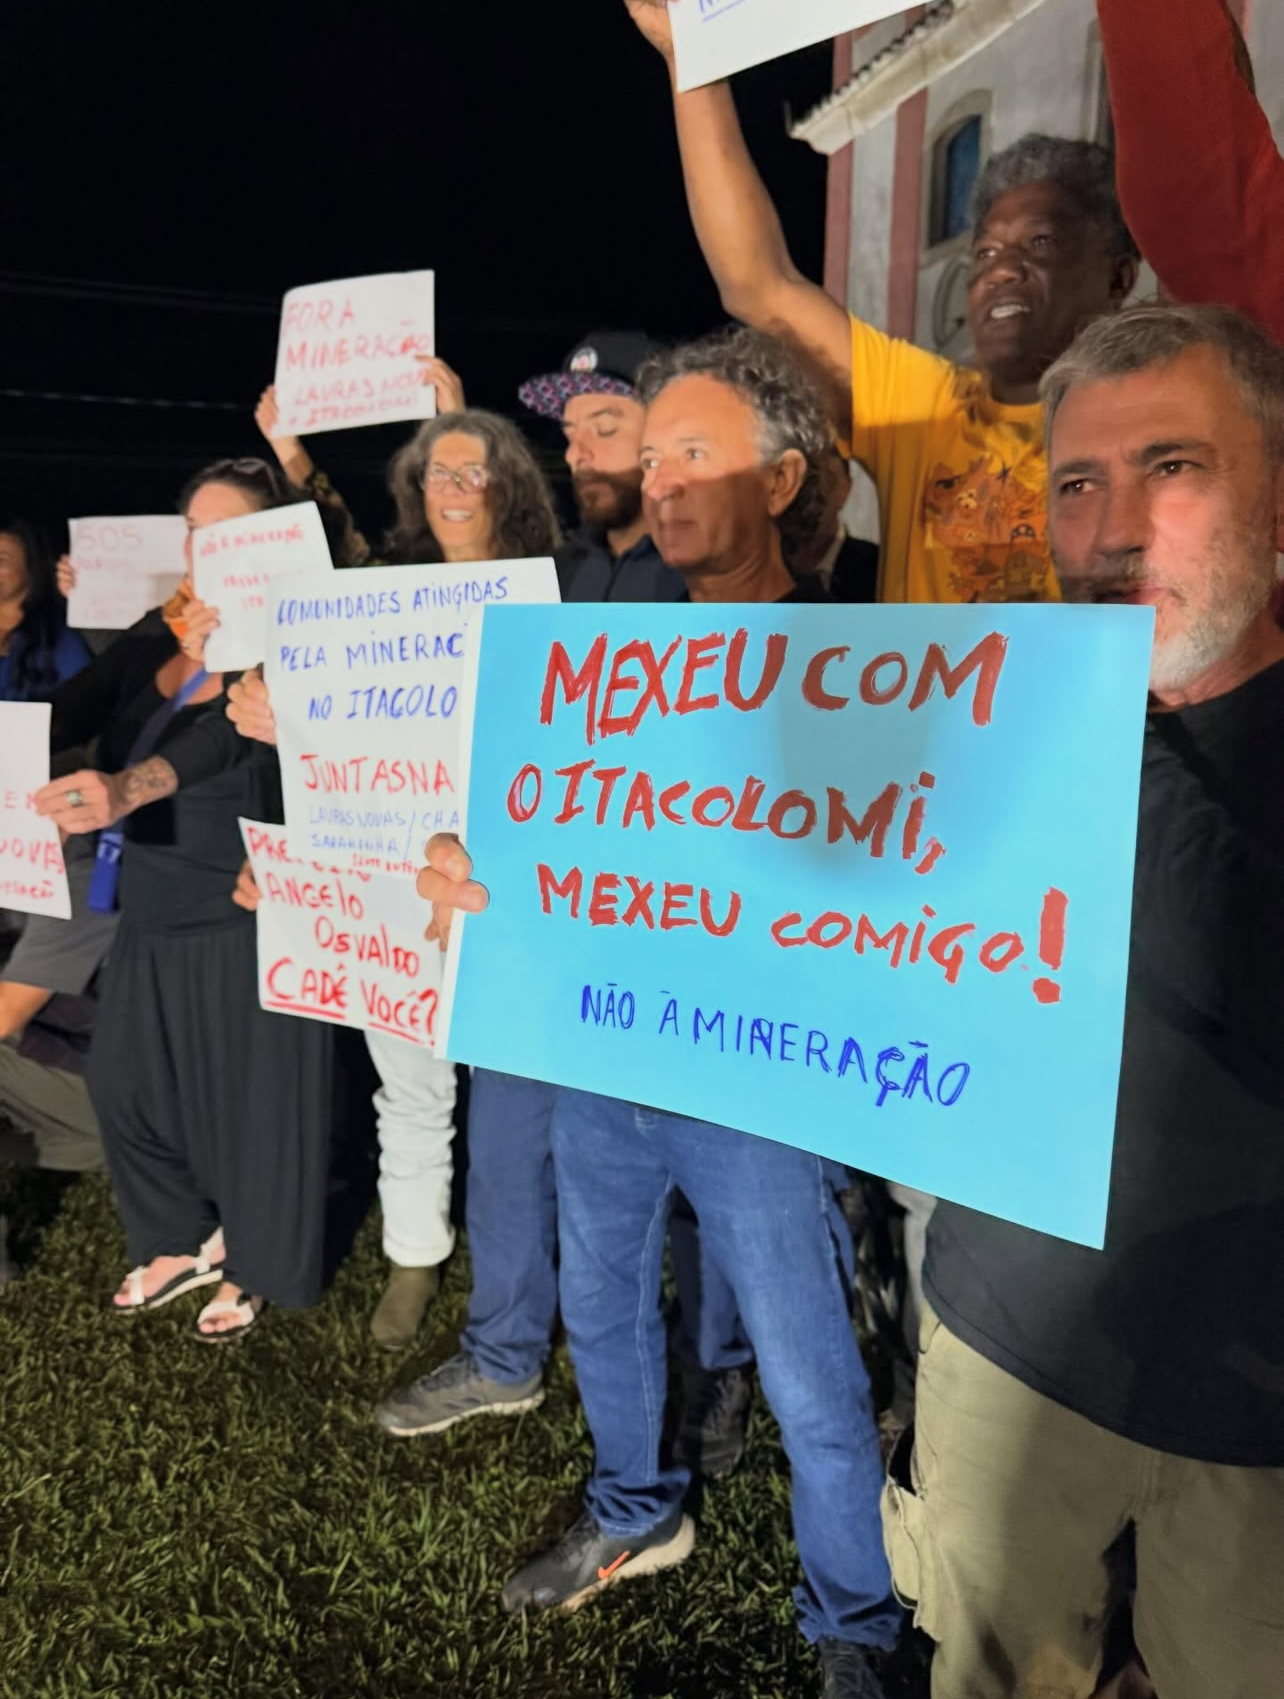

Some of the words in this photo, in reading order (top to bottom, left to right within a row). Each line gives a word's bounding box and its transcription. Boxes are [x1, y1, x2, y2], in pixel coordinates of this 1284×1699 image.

[78, 524, 143, 551] SOS
[276, 590, 401, 625] COMUNIDADES
[413, 576, 509, 613] ATINGIDAS
[280, 645, 327, 671] PELA
[308, 694, 333, 720] NO
[540, 628, 789, 746] MEXEU
[801, 631, 1009, 727] COM
[536, 863, 742, 937] MEXEU
[579, 982, 636, 1031] NÃO
[692, 1007, 972, 1108] MINERAÇÃO
